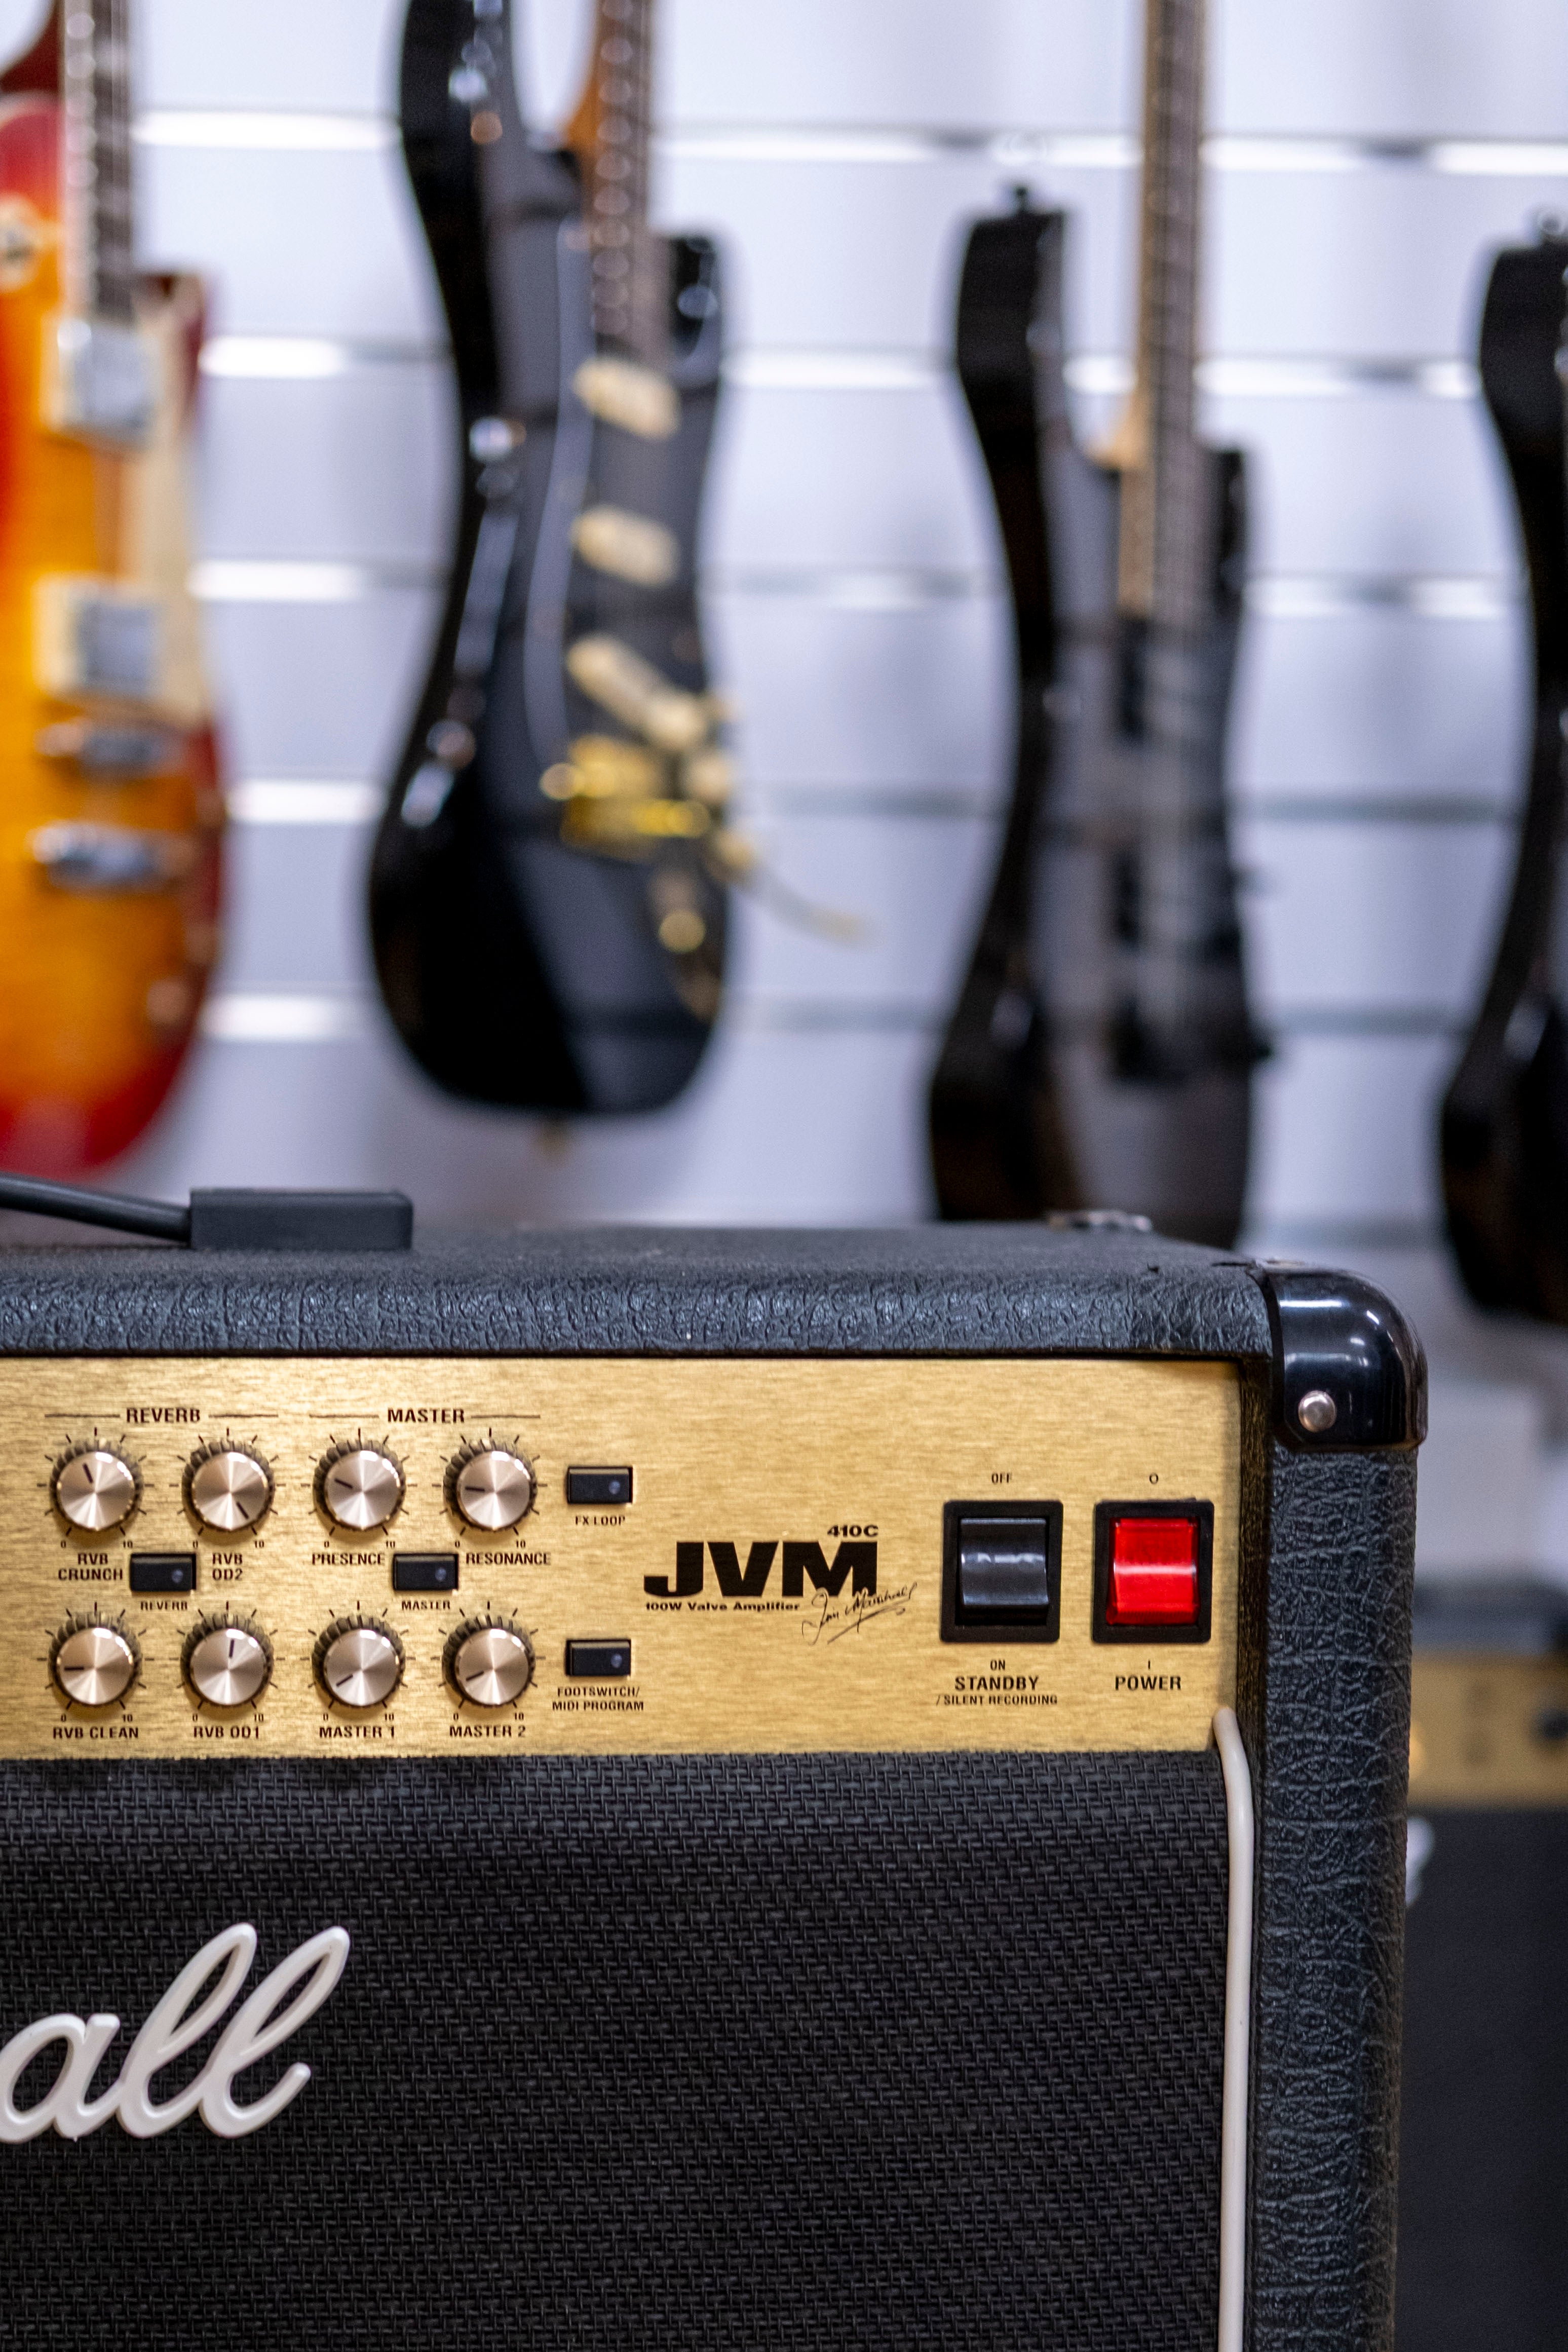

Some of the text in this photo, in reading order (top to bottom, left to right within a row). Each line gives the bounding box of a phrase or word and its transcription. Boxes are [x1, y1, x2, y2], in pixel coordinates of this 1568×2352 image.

[126, 1407, 200, 1424] REVERB
[388, 1408, 465, 1424] MASTER
[991, 1472, 1012, 1484] OFF
[575, 1515, 626, 1526] FX LOOP
[827, 1524, 878, 1537] 410C
[123, 1540, 133, 1549] 10
[254, 1540, 264, 1549] 10
[386, 1540, 396, 1549] 10
[516, 1540, 526, 1548] 10
[78, 1551, 108, 1565] RVB
[212, 1552, 243, 1565] RVB
[312, 1552, 386, 1566] PRESENCE
[466, 1552, 551, 1566] RESONANCE
[58, 1568, 123, 1581] CRUNCH
[212, 1568, 243, 1581] OD2
[644, 1541, 877, 1598] JVM
[140, 1600, 187, 1611] REVERB
[401, 1600, 450, 1611] MASTER
[646, 1602, 800, 1613] 100W Valve Amplifier
[990, 1659, 1006, 1671] ON
[954, 1676, 1039, 1691] STANDBY
[1115, 1675, 1181, 1691] POWER
[552, 1700, 644, 1711] MIDI PROGRAM
[944, 1694, 986, 1705] SILENT
[988, 1695, 1057, 1705] RECORDING
[122, 1714, 133, 1722] 10
[254, 1714, 264, 1723] 10
[384, 1713, 395, 1721] 10
[514, 1712, 524, 1721] 10
[53, 1726, 138, 1739] RVB CLEAN
[194, 1725, 260, 1739] RVB OD1
[319, 1724, 395, 1738] MASTER 1
[449, 1725, 526, 1738] MASTER 2
